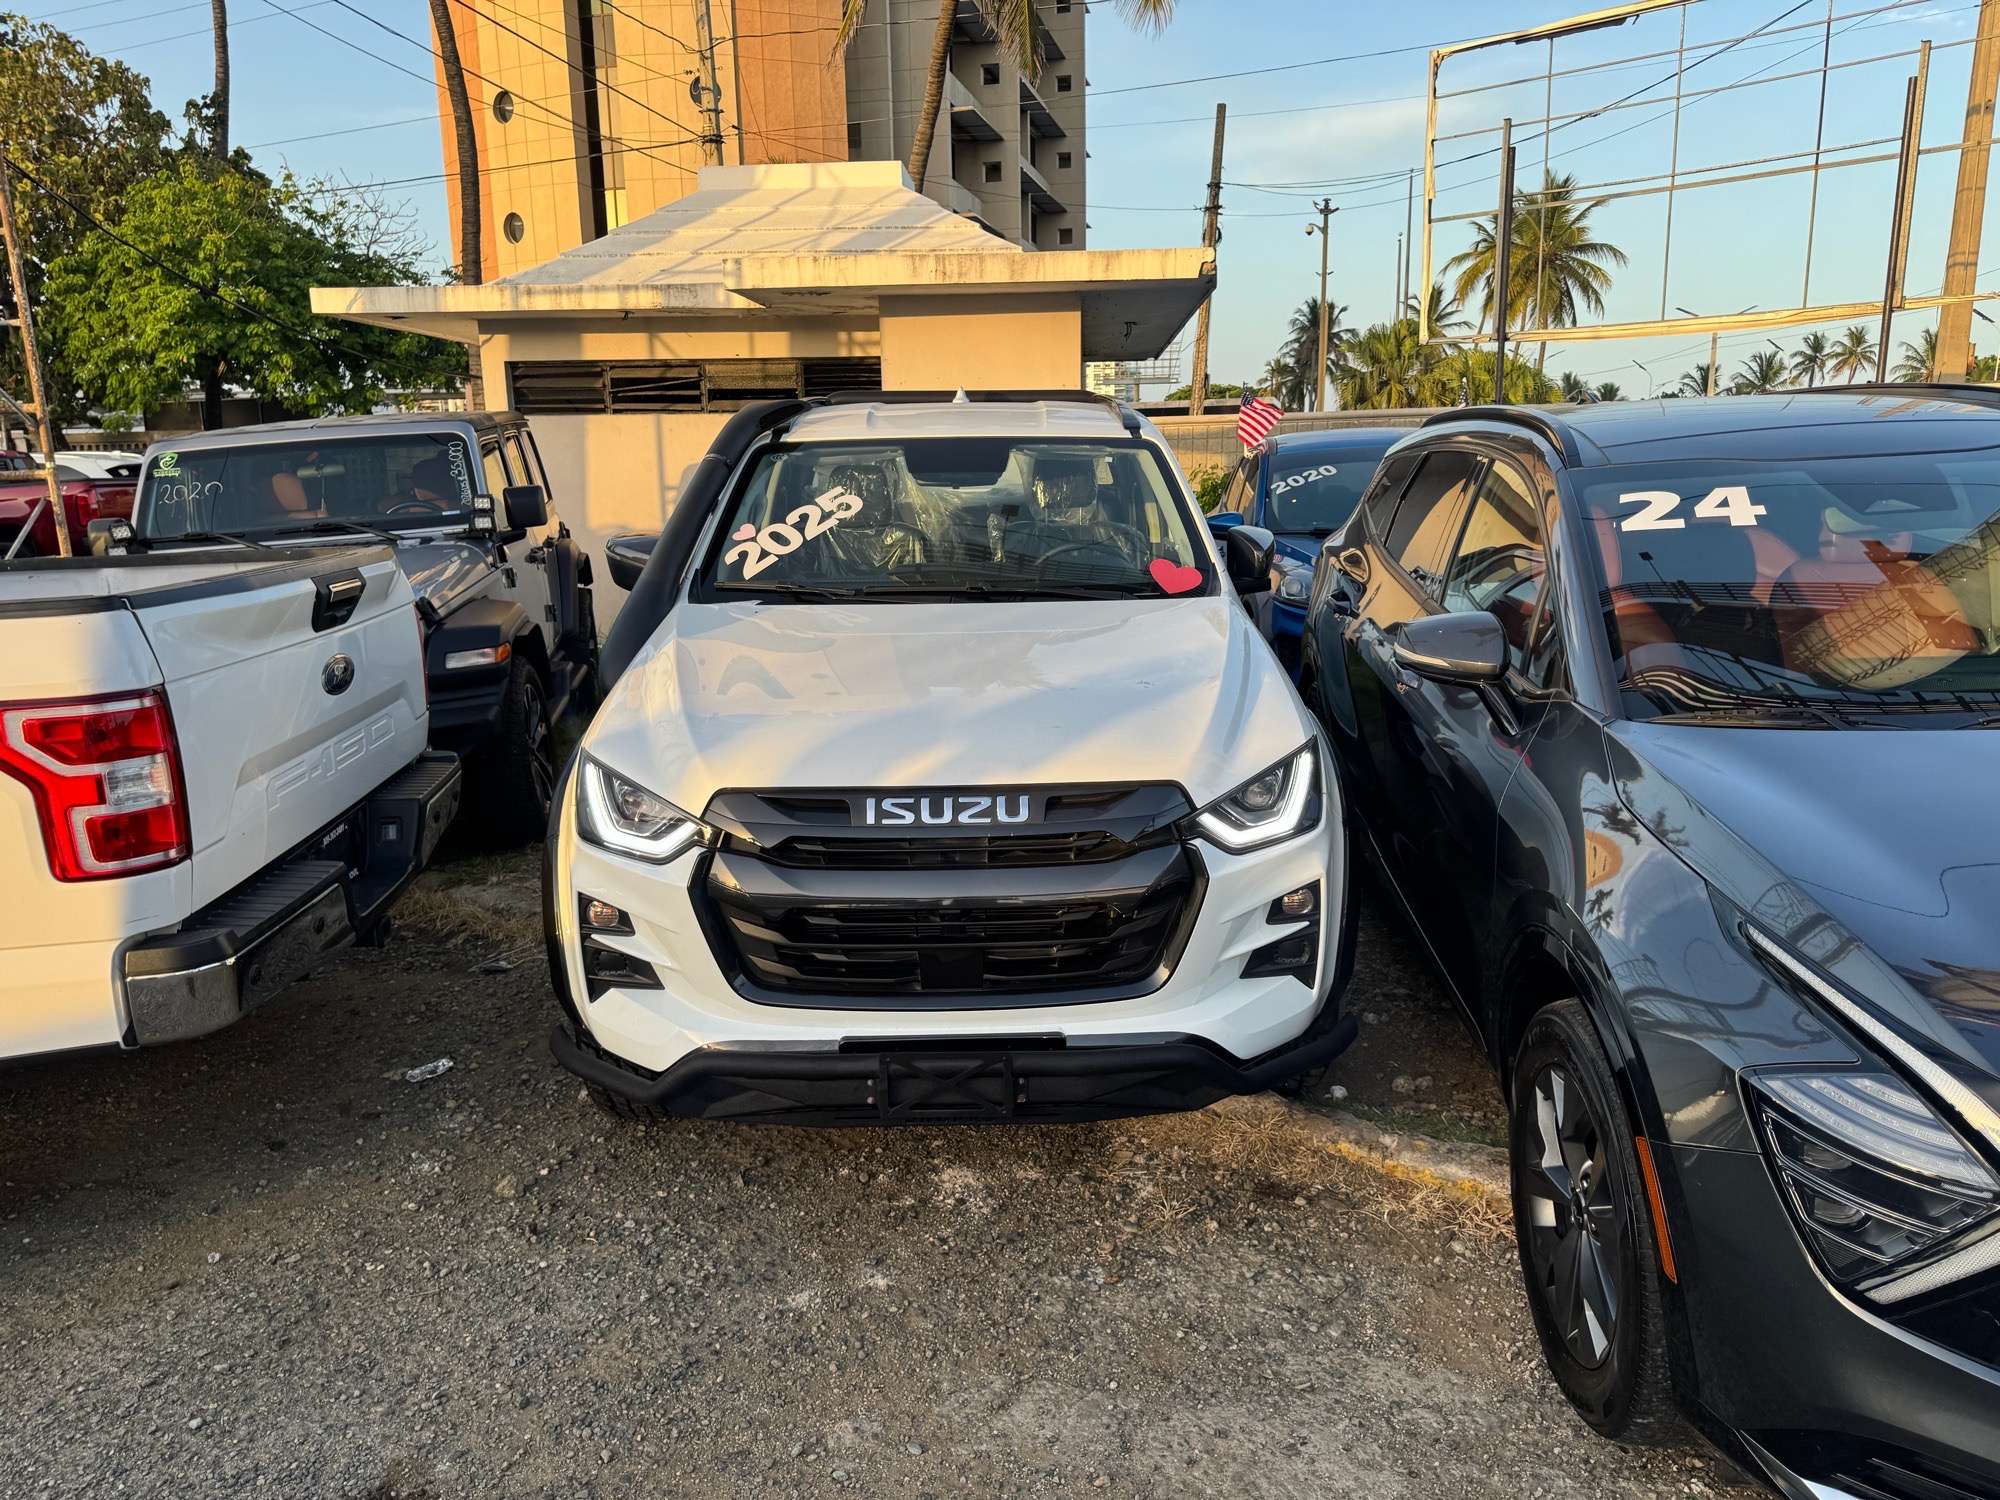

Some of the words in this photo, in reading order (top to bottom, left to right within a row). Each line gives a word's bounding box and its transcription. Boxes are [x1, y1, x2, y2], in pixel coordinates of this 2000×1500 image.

[159, 481, 223, 504] 2020
[1270, 465, 1338, 495] 2020
[1619, 486, 1768, 531] 24
[724, 486, 864, 581] 2025
[265, 712, 396, 812] F-150
[866, 795, 1029, 825] ISUZU
